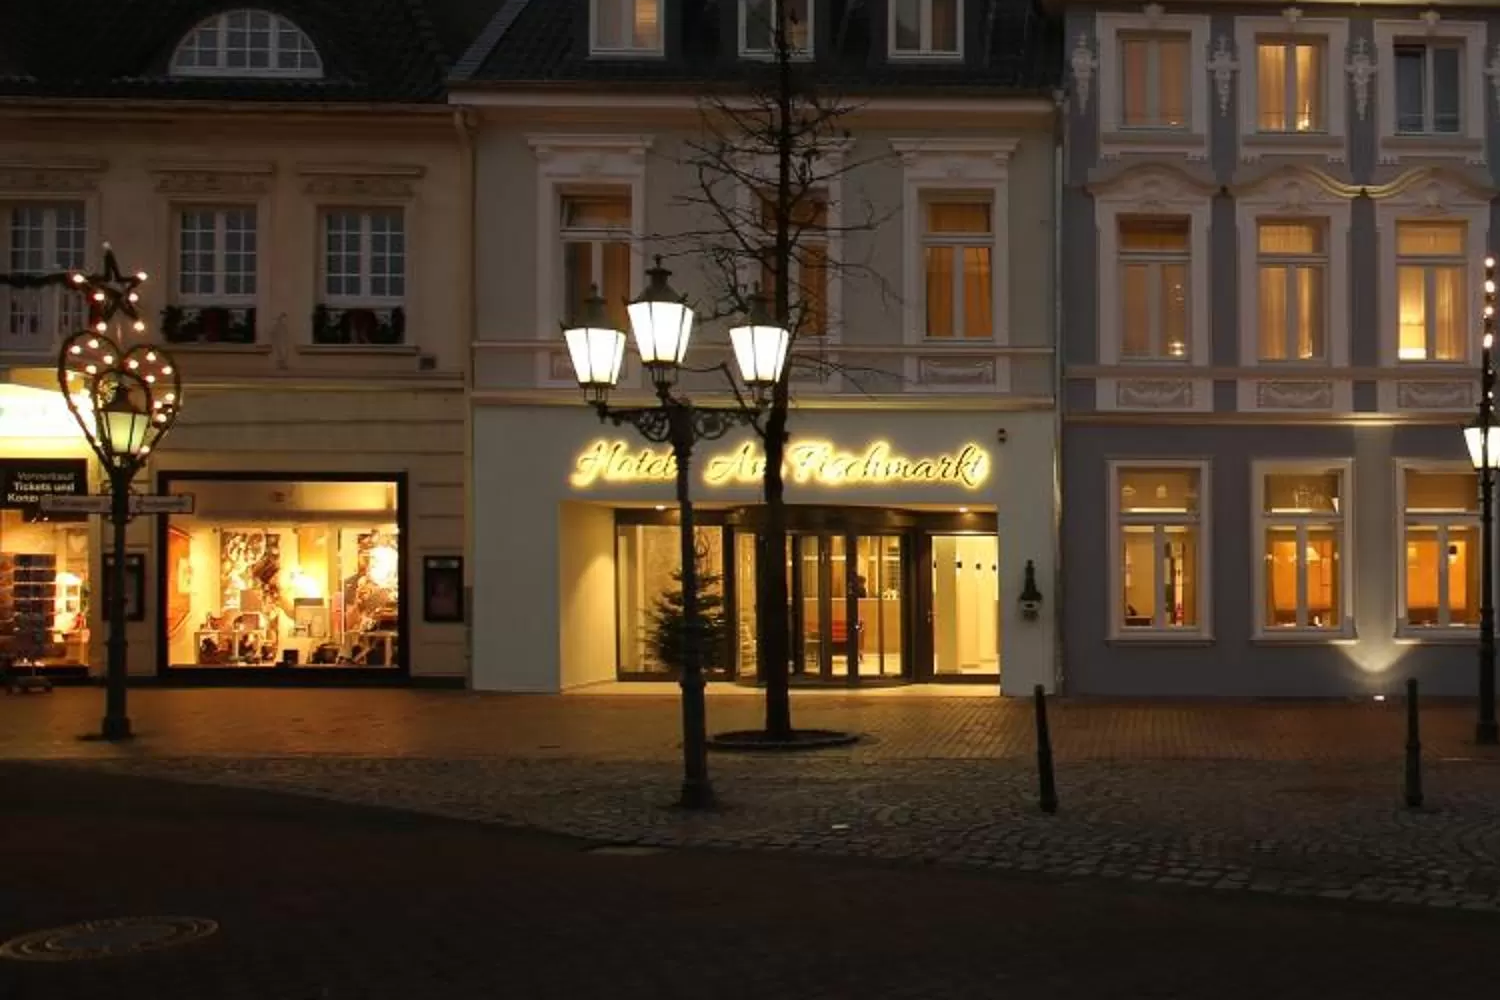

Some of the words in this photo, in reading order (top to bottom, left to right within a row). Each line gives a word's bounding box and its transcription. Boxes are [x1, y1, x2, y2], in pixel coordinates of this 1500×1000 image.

[571, 441, 679, 486] Hotel
[790, 441, 987, 487] Fischmarkt
[13, 481, 52, 491] Tickets
[53, 481, 75, 492] und
